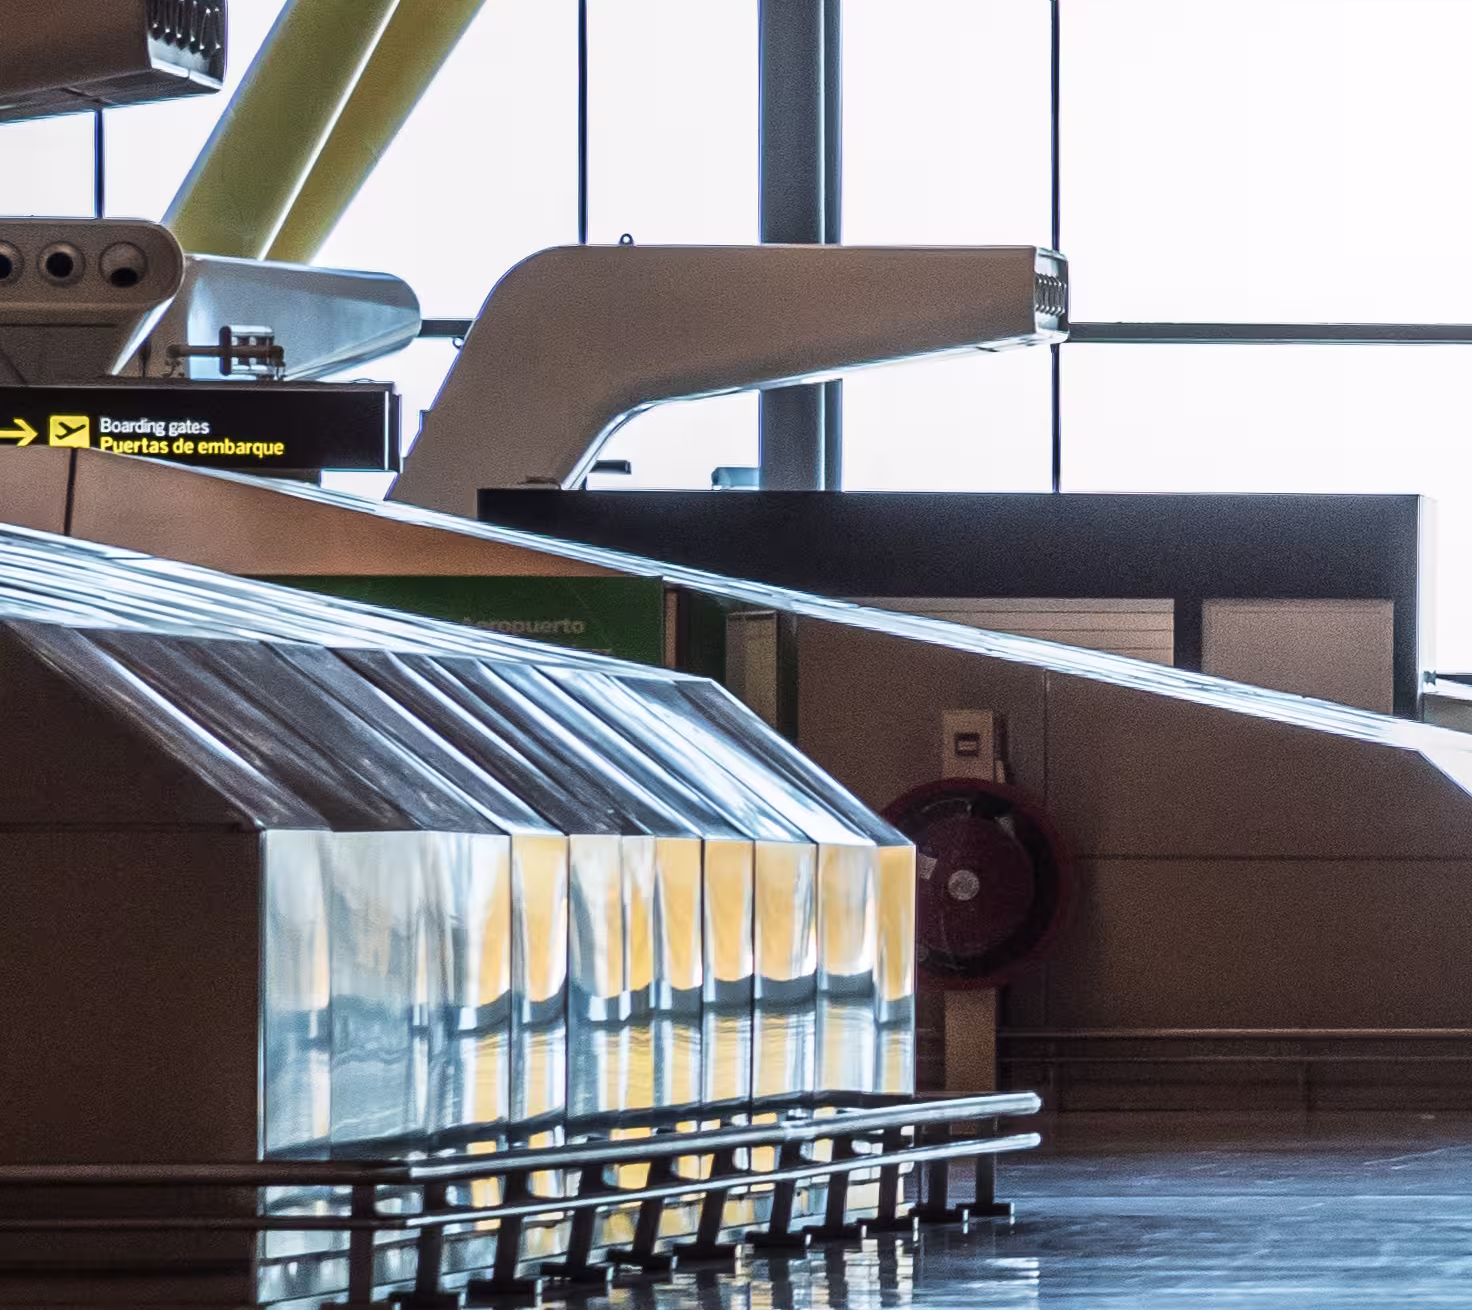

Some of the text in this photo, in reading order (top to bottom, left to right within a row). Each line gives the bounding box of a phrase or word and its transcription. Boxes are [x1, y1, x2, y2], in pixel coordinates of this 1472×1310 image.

[99, 417, 211, 437] Boarding gates
[99, 436, 285, 460] Puertas de embarque
